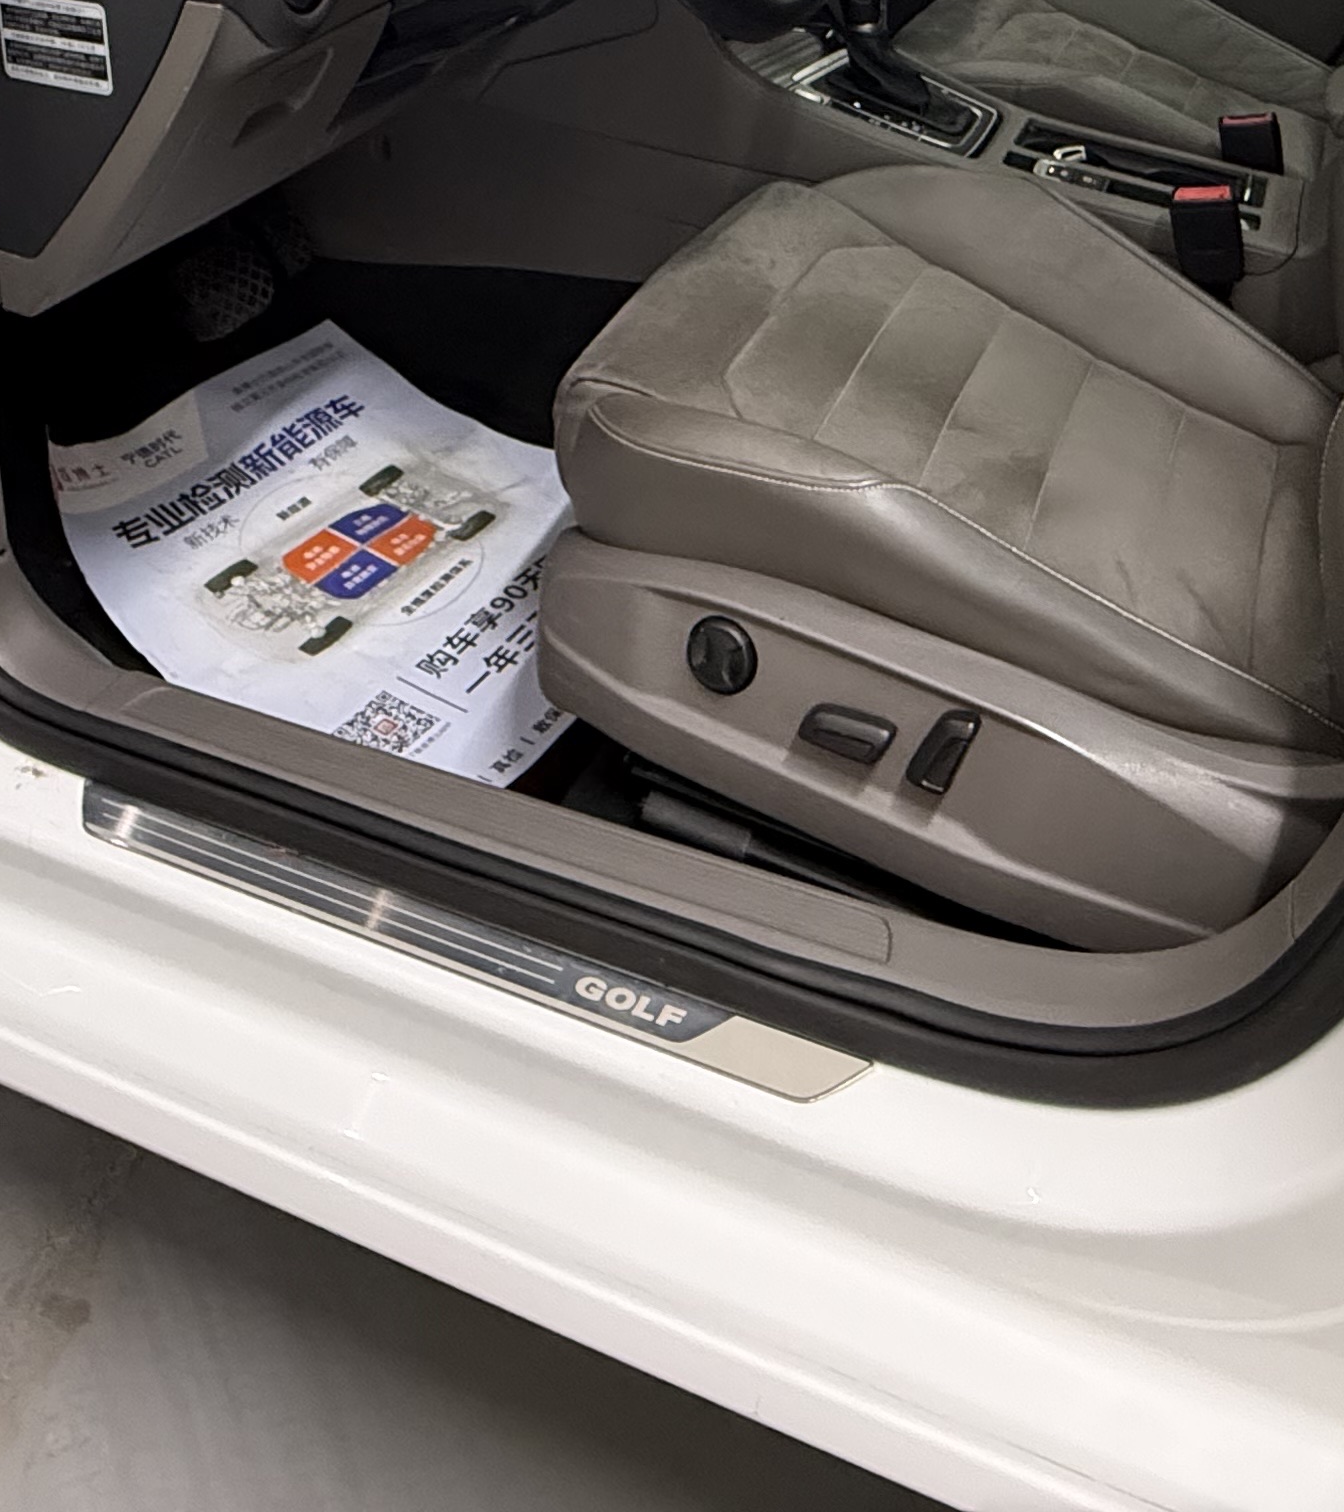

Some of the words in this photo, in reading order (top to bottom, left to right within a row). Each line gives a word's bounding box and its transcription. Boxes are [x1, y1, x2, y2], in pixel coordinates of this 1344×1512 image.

[112, 394, 366, 549] 专业检测新能源车
[144, 446, 183, 468] CATL
[183, 514, 239, 550] 新技术
[415, 555, 547, 679] 购车享90天
[466, 611, 538, 694] 一年三
[574, 975, 688, 1027] GOLF
